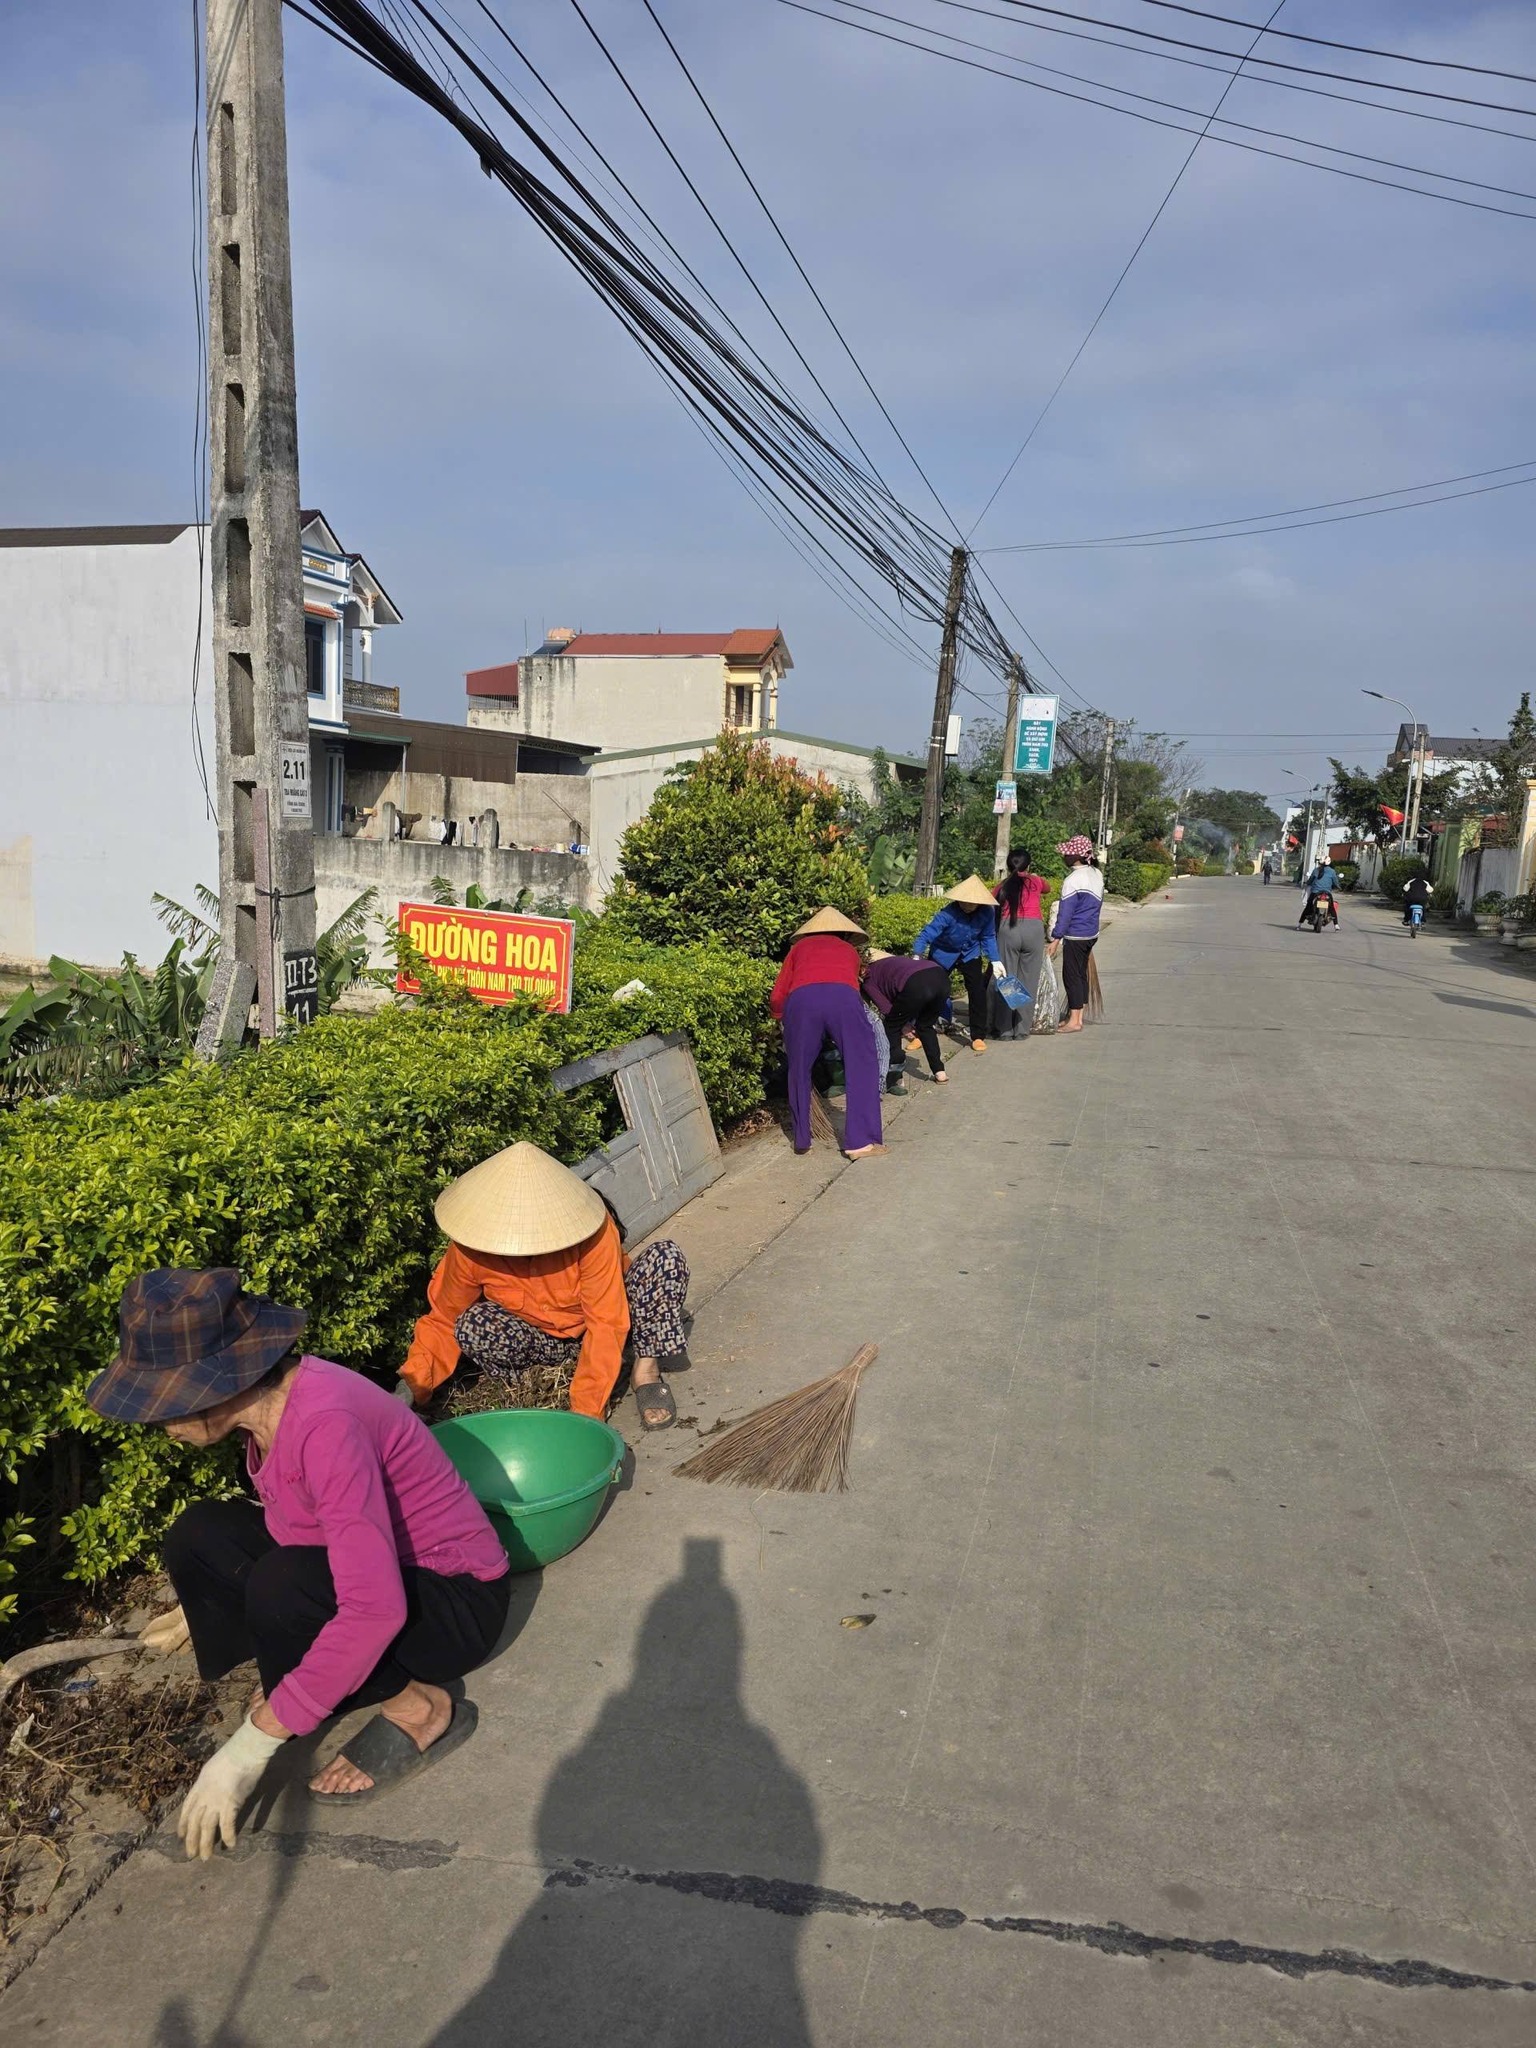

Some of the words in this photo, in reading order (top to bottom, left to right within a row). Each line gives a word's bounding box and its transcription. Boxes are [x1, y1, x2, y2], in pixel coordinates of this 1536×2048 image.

[284, 760, 304, 780] 2.11
[410, 917, 498, 966] ĐƯỜNG
[506, 932, 558, 972] HOA
[466, 966, 486, 990] THÔN
[488, 972, 506, 992] NAM
[292, 1000, 310, 1026] 11
